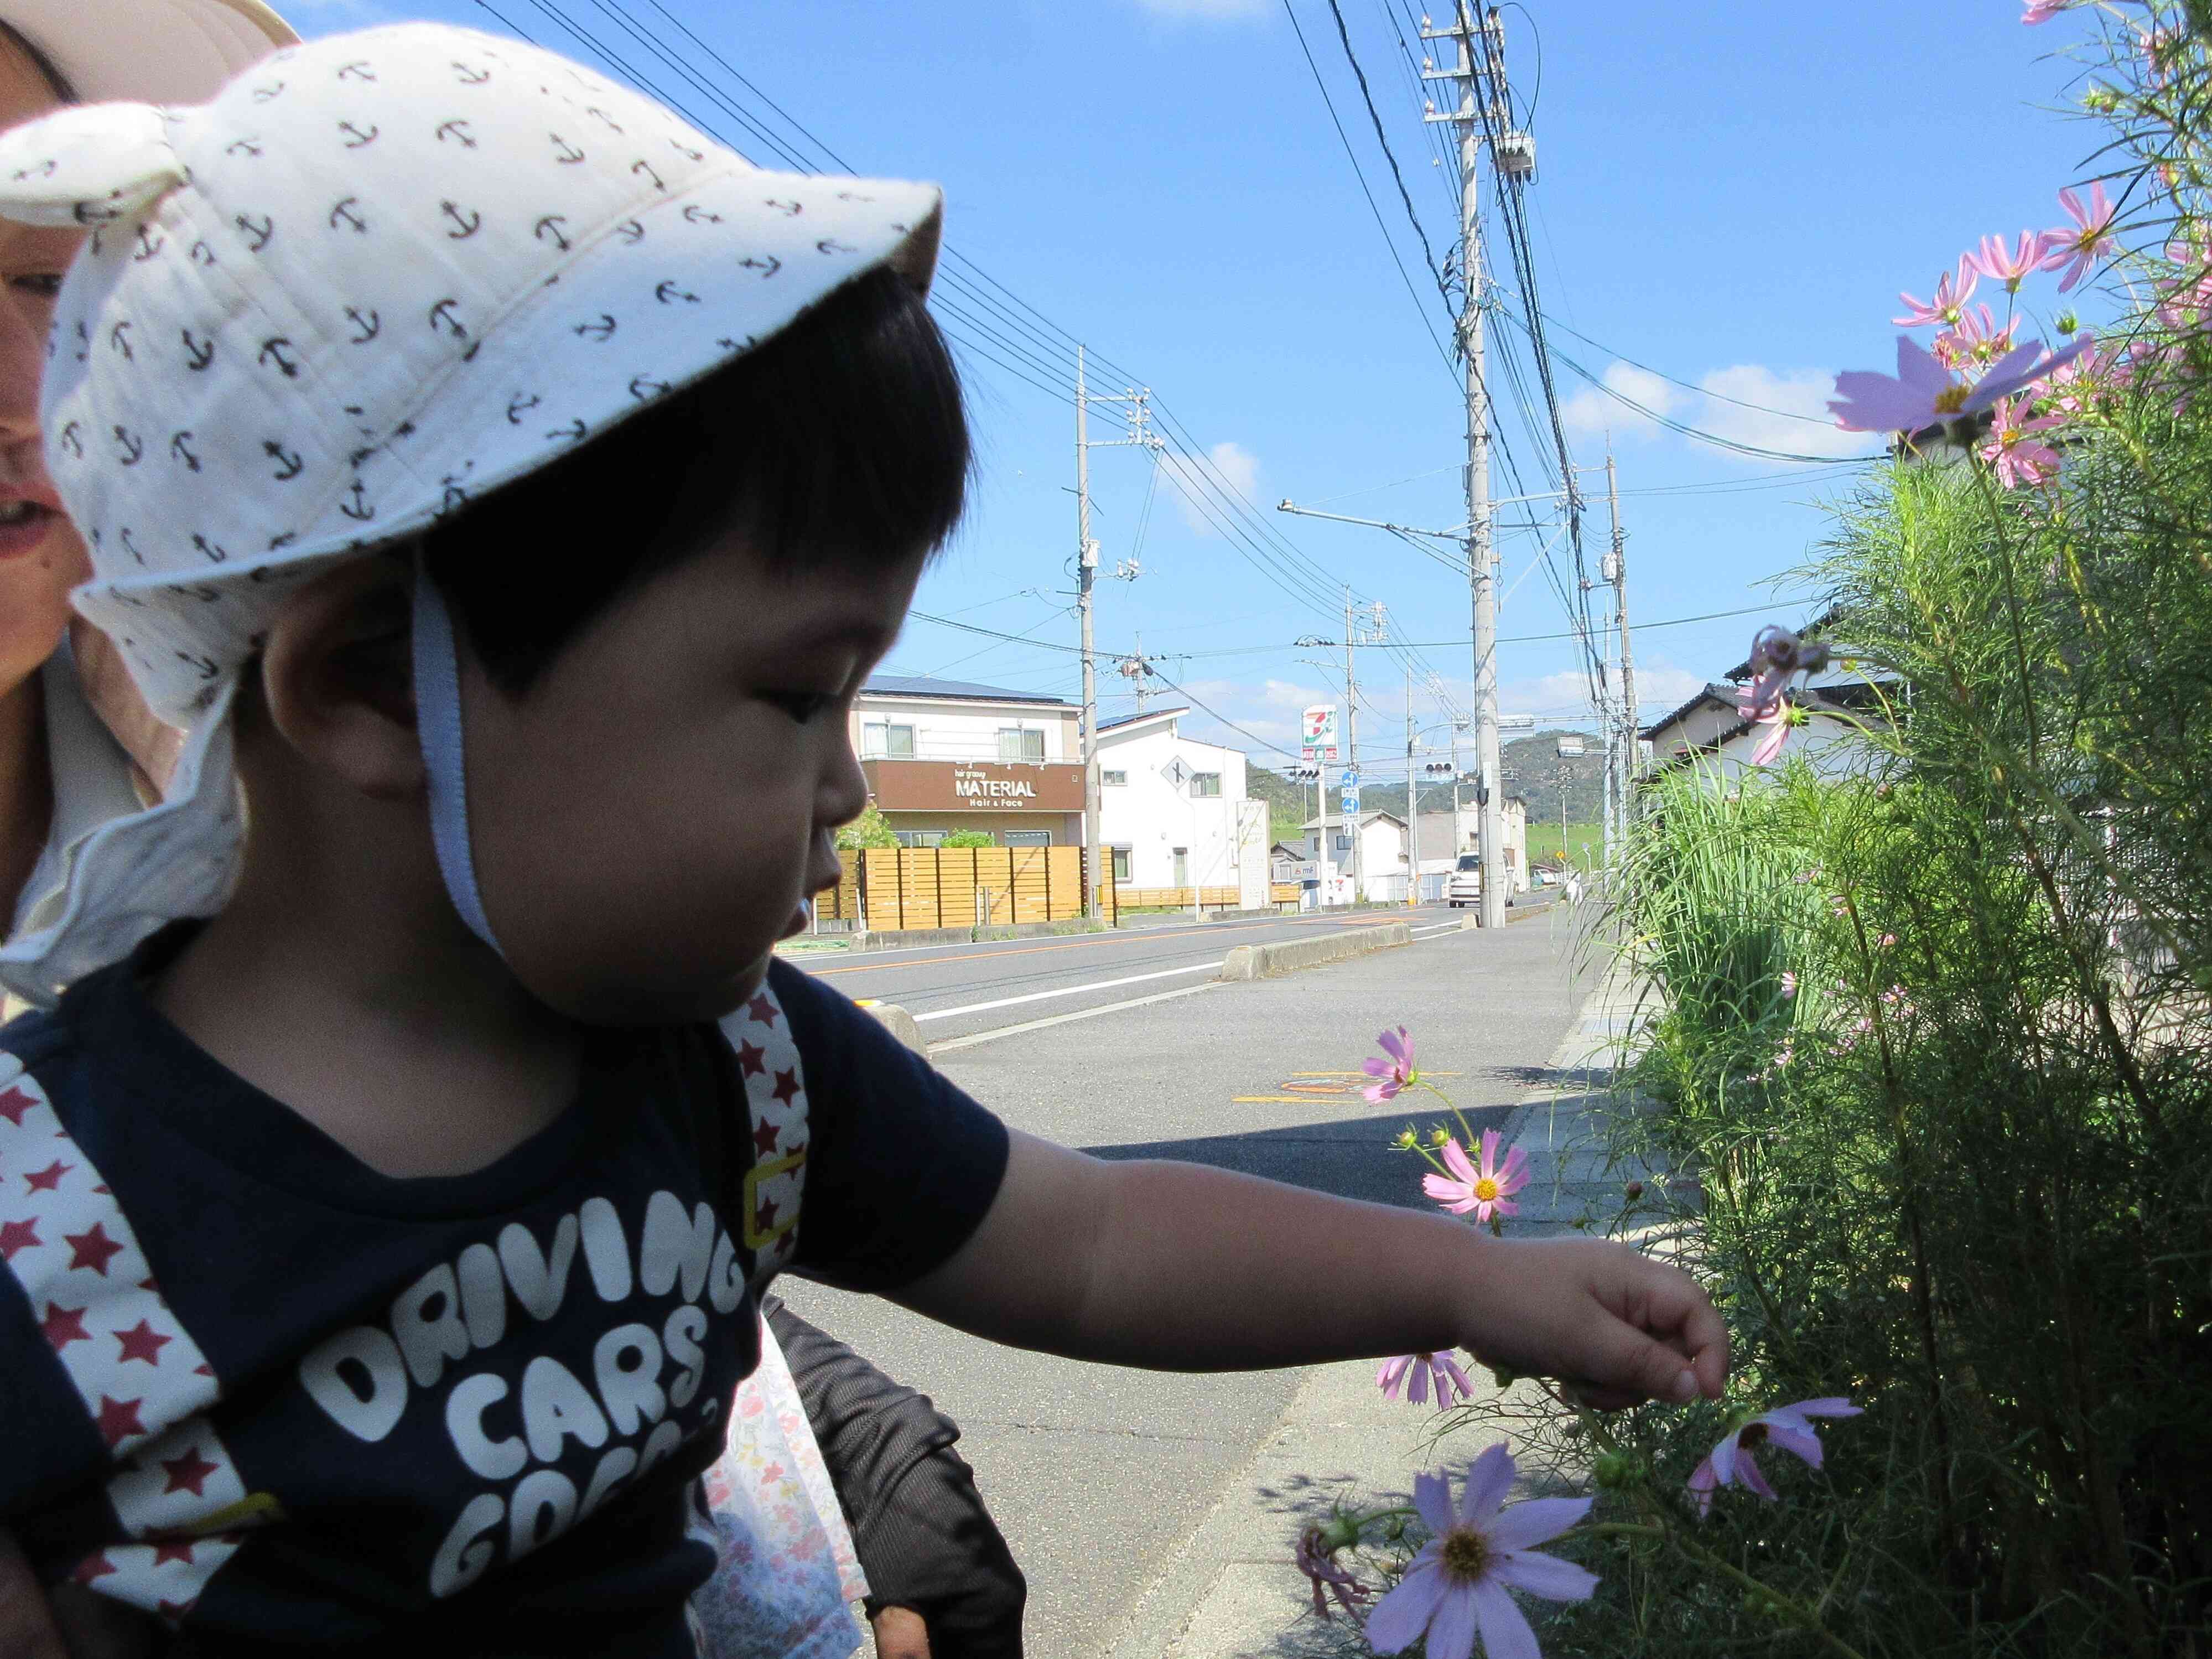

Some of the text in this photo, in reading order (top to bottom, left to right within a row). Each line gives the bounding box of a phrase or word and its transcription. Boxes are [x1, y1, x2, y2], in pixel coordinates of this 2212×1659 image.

[954, 769, 965, 777] hair
[955, 780, 1037, 797] MATERIAL
[969, 799, 990, 807] Hair
[1001, 799, 1023, 807] Face
[299, 1190, 744, 1442] DRIVING
[446, 1305, 708, 1480] CARS
